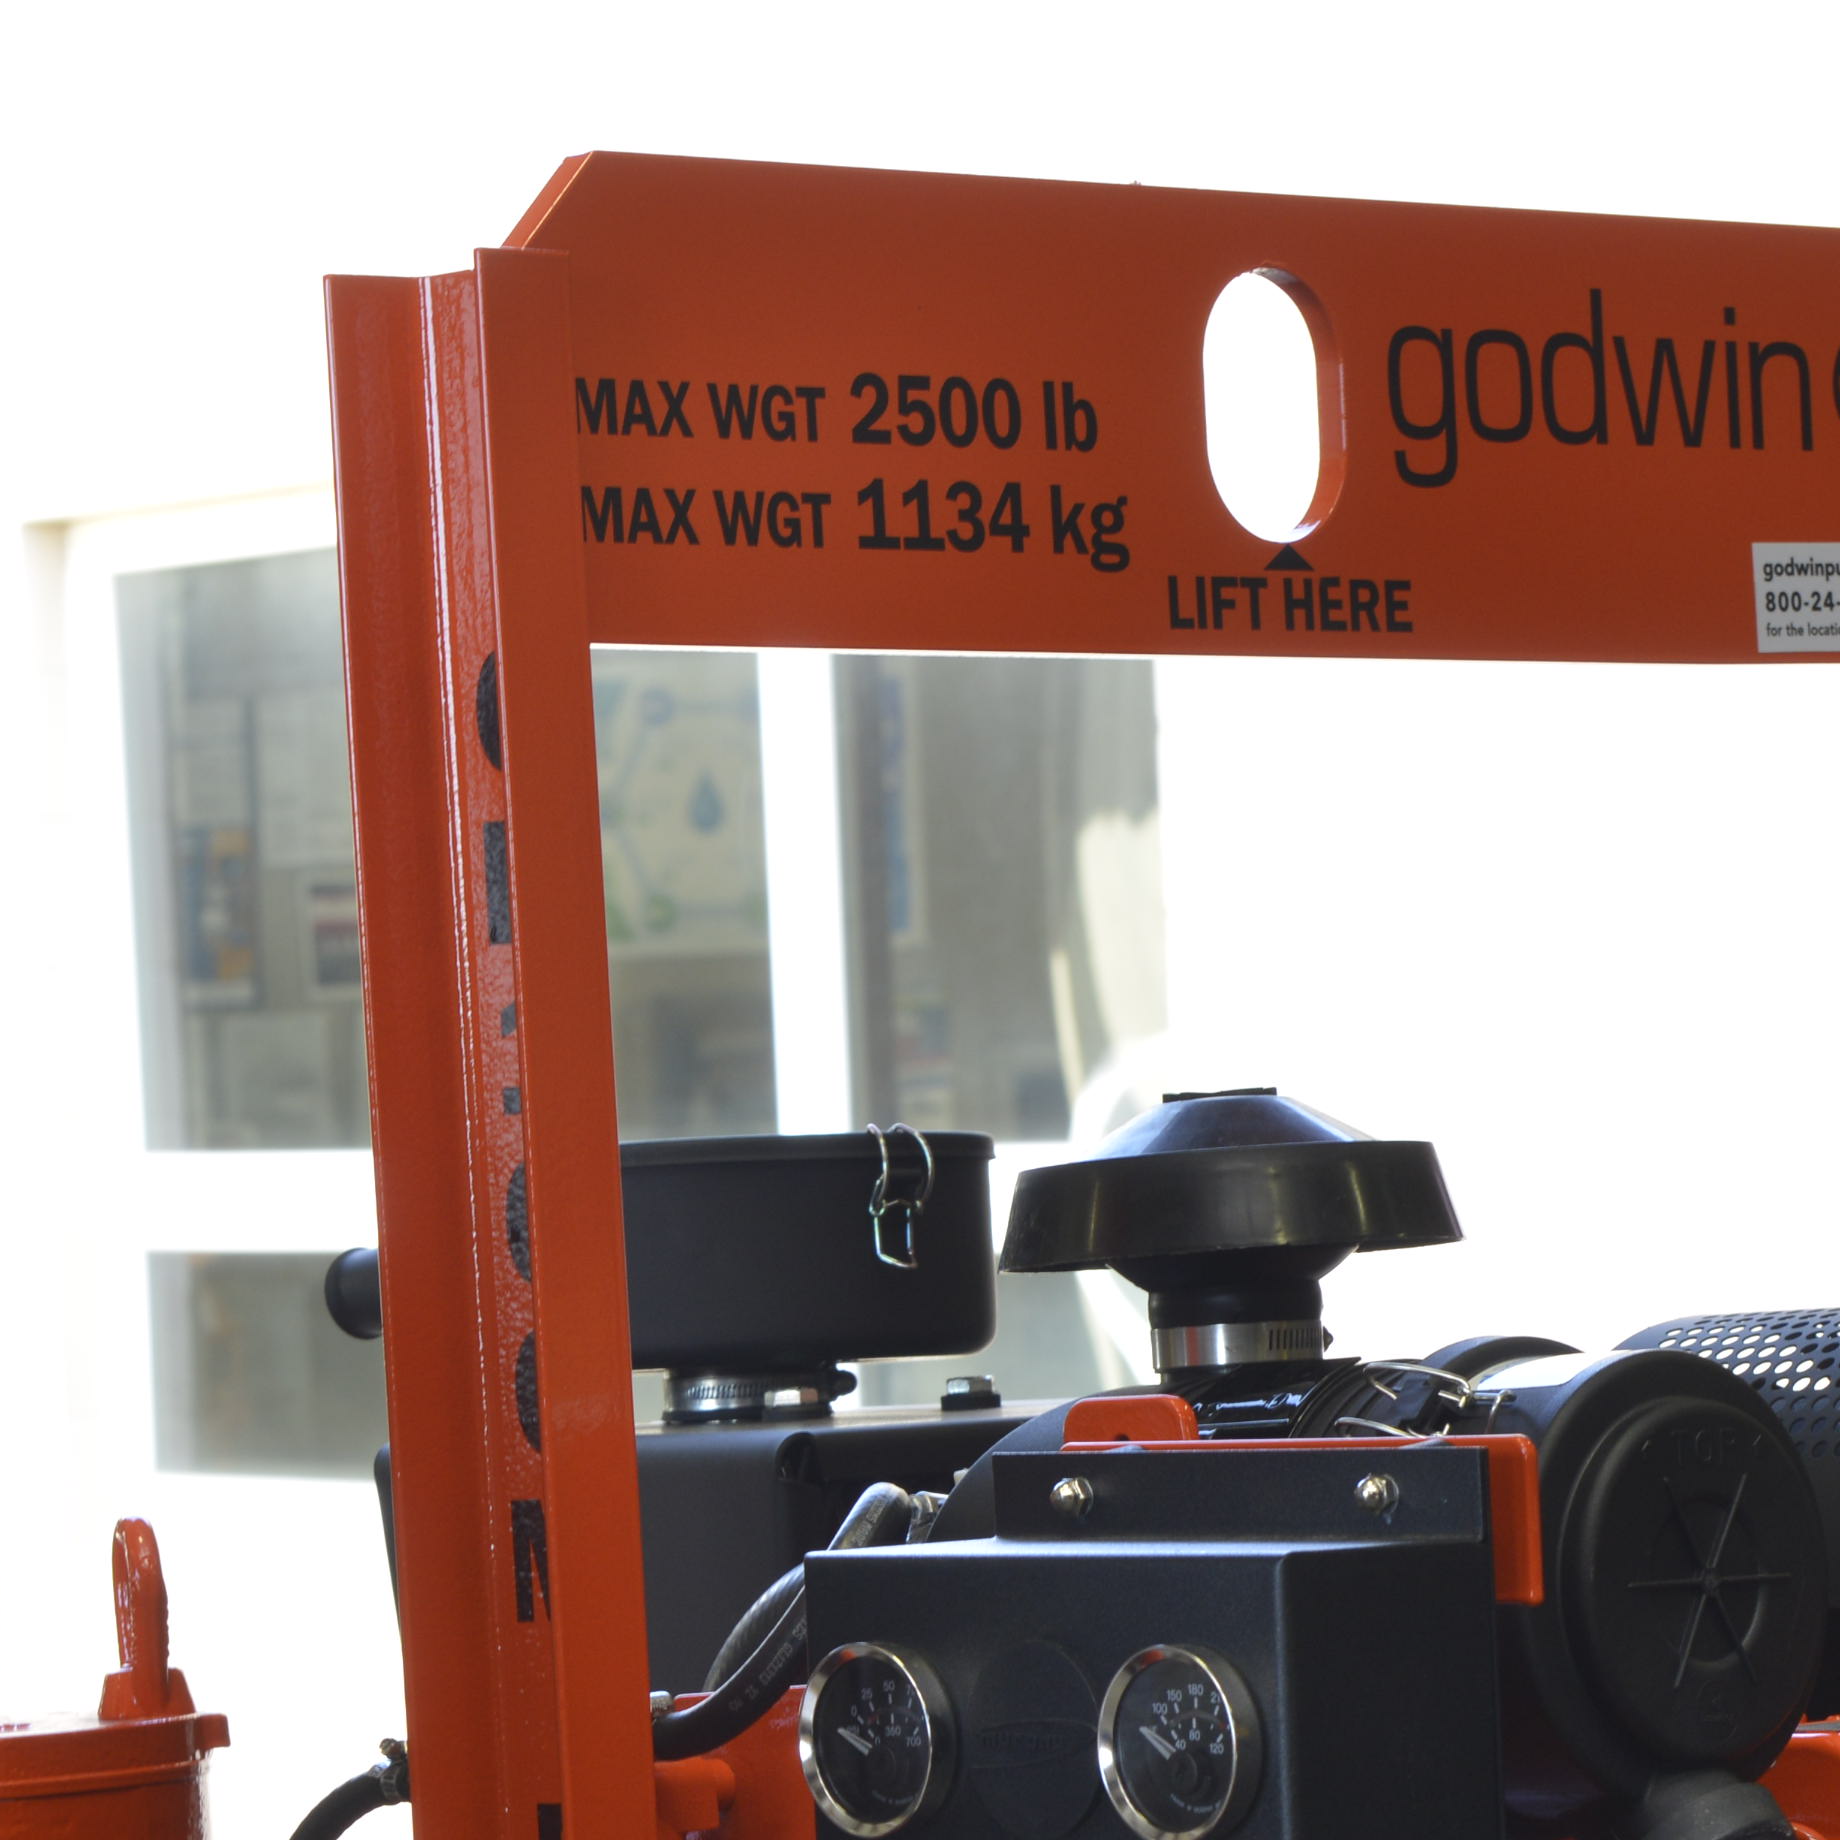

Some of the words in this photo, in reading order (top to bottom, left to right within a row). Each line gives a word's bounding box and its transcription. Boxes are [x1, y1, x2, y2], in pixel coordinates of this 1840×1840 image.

[1386, 288, 1813, 488] godwin
[575, 377, 694, 438] MAX
[707, 382, 826, 442] WGT
[850, 372, 1021, 449] 2500
[1042, 380, 1098, 453] lb
[580, 485, 700, 545] MAX
[713, 490, 832, 548] WGT
[857, 477, 1029, 553] 1134
[1050, 484, 1130, 573] kg
[1167, 575, 1267, 632] LIFT
[1283, 577, 1413, 633] HERE
[1766, 622, 1782, 637] for
[1786, 622, 1804, 637] the
[1166, 1689, 1182, 1702] 150
[1187, 1683, 1204, 1696] 180
[1152, 1702, 1168, 1715] 100
